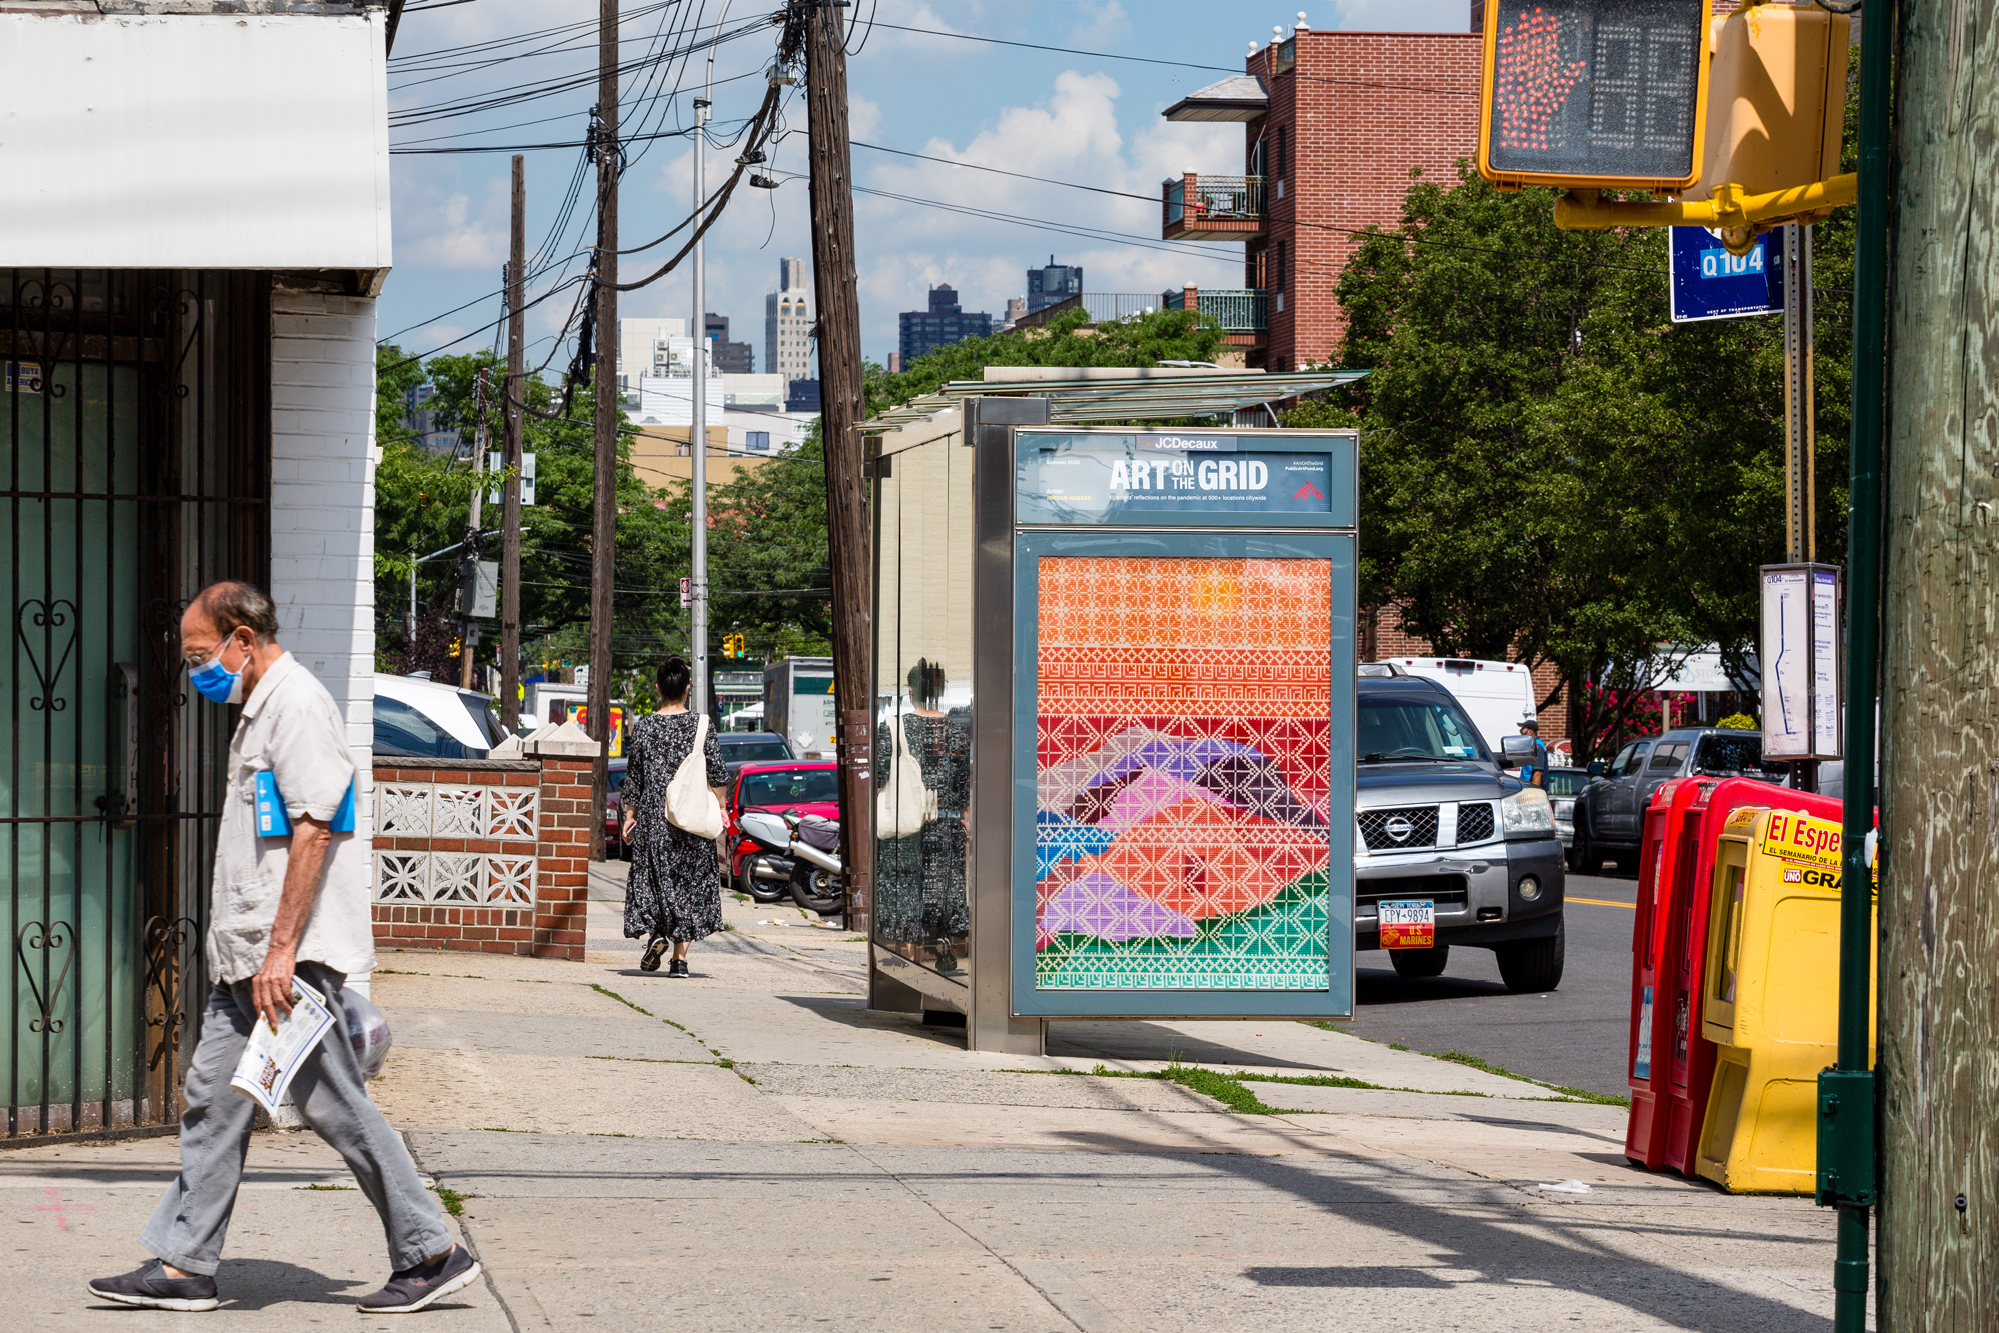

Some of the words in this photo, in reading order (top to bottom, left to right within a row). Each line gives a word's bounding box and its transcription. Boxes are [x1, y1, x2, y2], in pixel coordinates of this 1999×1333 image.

[1703, 247, 1763, 276] Q104
[21, 366, 34, 375] BUY
[6, 377, 39, 387] AERICN
[1155, 437, 1218, 449] JCDecaux
[1109, 460, 1170, 490] ART
[1172, 460, 1194, 476] ON
[1198, 460, 1268, 490] GRID
[1172, 477, 1195, 490] THE
[1766, 574, 1782, 584] Q104
[1768, 814, 1789, 842] El
[1792, 818, 1843, 856] Espe
[1778, 849, 1817, 862] SEMANARIO
[1829, 858, 1838, 866] LA
[1784, 872, 1801, 882] UNO
[1802, 870, 1842, 889] GRA
[1408, 926, 1423, 936] U.S.
[1399, 935, 1432, 945] MARINES
